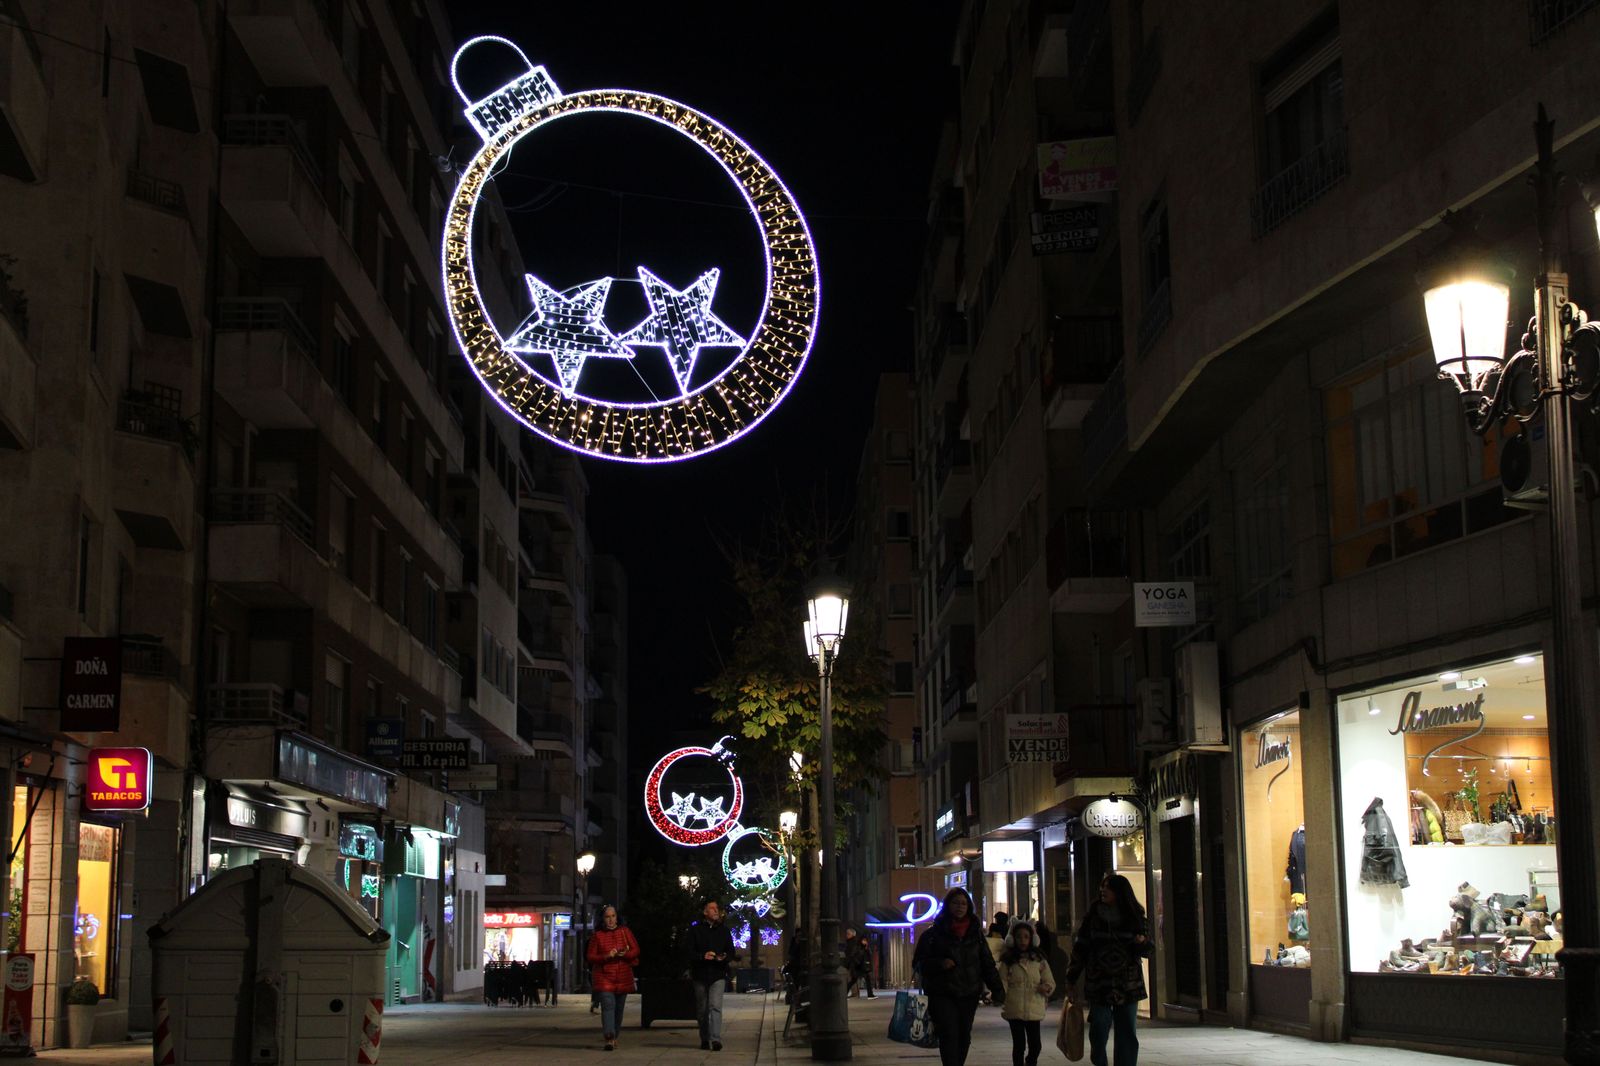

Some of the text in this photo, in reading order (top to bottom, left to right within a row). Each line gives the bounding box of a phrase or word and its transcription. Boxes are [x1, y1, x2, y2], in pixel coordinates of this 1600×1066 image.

[1142, 588, 1187, 600] YOGA
[75, 657, 108, 675] DOÑA
[67, 694, 115, 709] CARMEN
[369, 736, 399, 745] Allianz
[1012, 738, 1067, 751] VENDE
[403, 741, 466, 752] GESTORIA
[1009, 751, 1028, 762] 923
[1032, 751, 1042, 762] 12
[1046, 751, 1057, 762] 54
[91, 791, 142, 801] TABACOS
